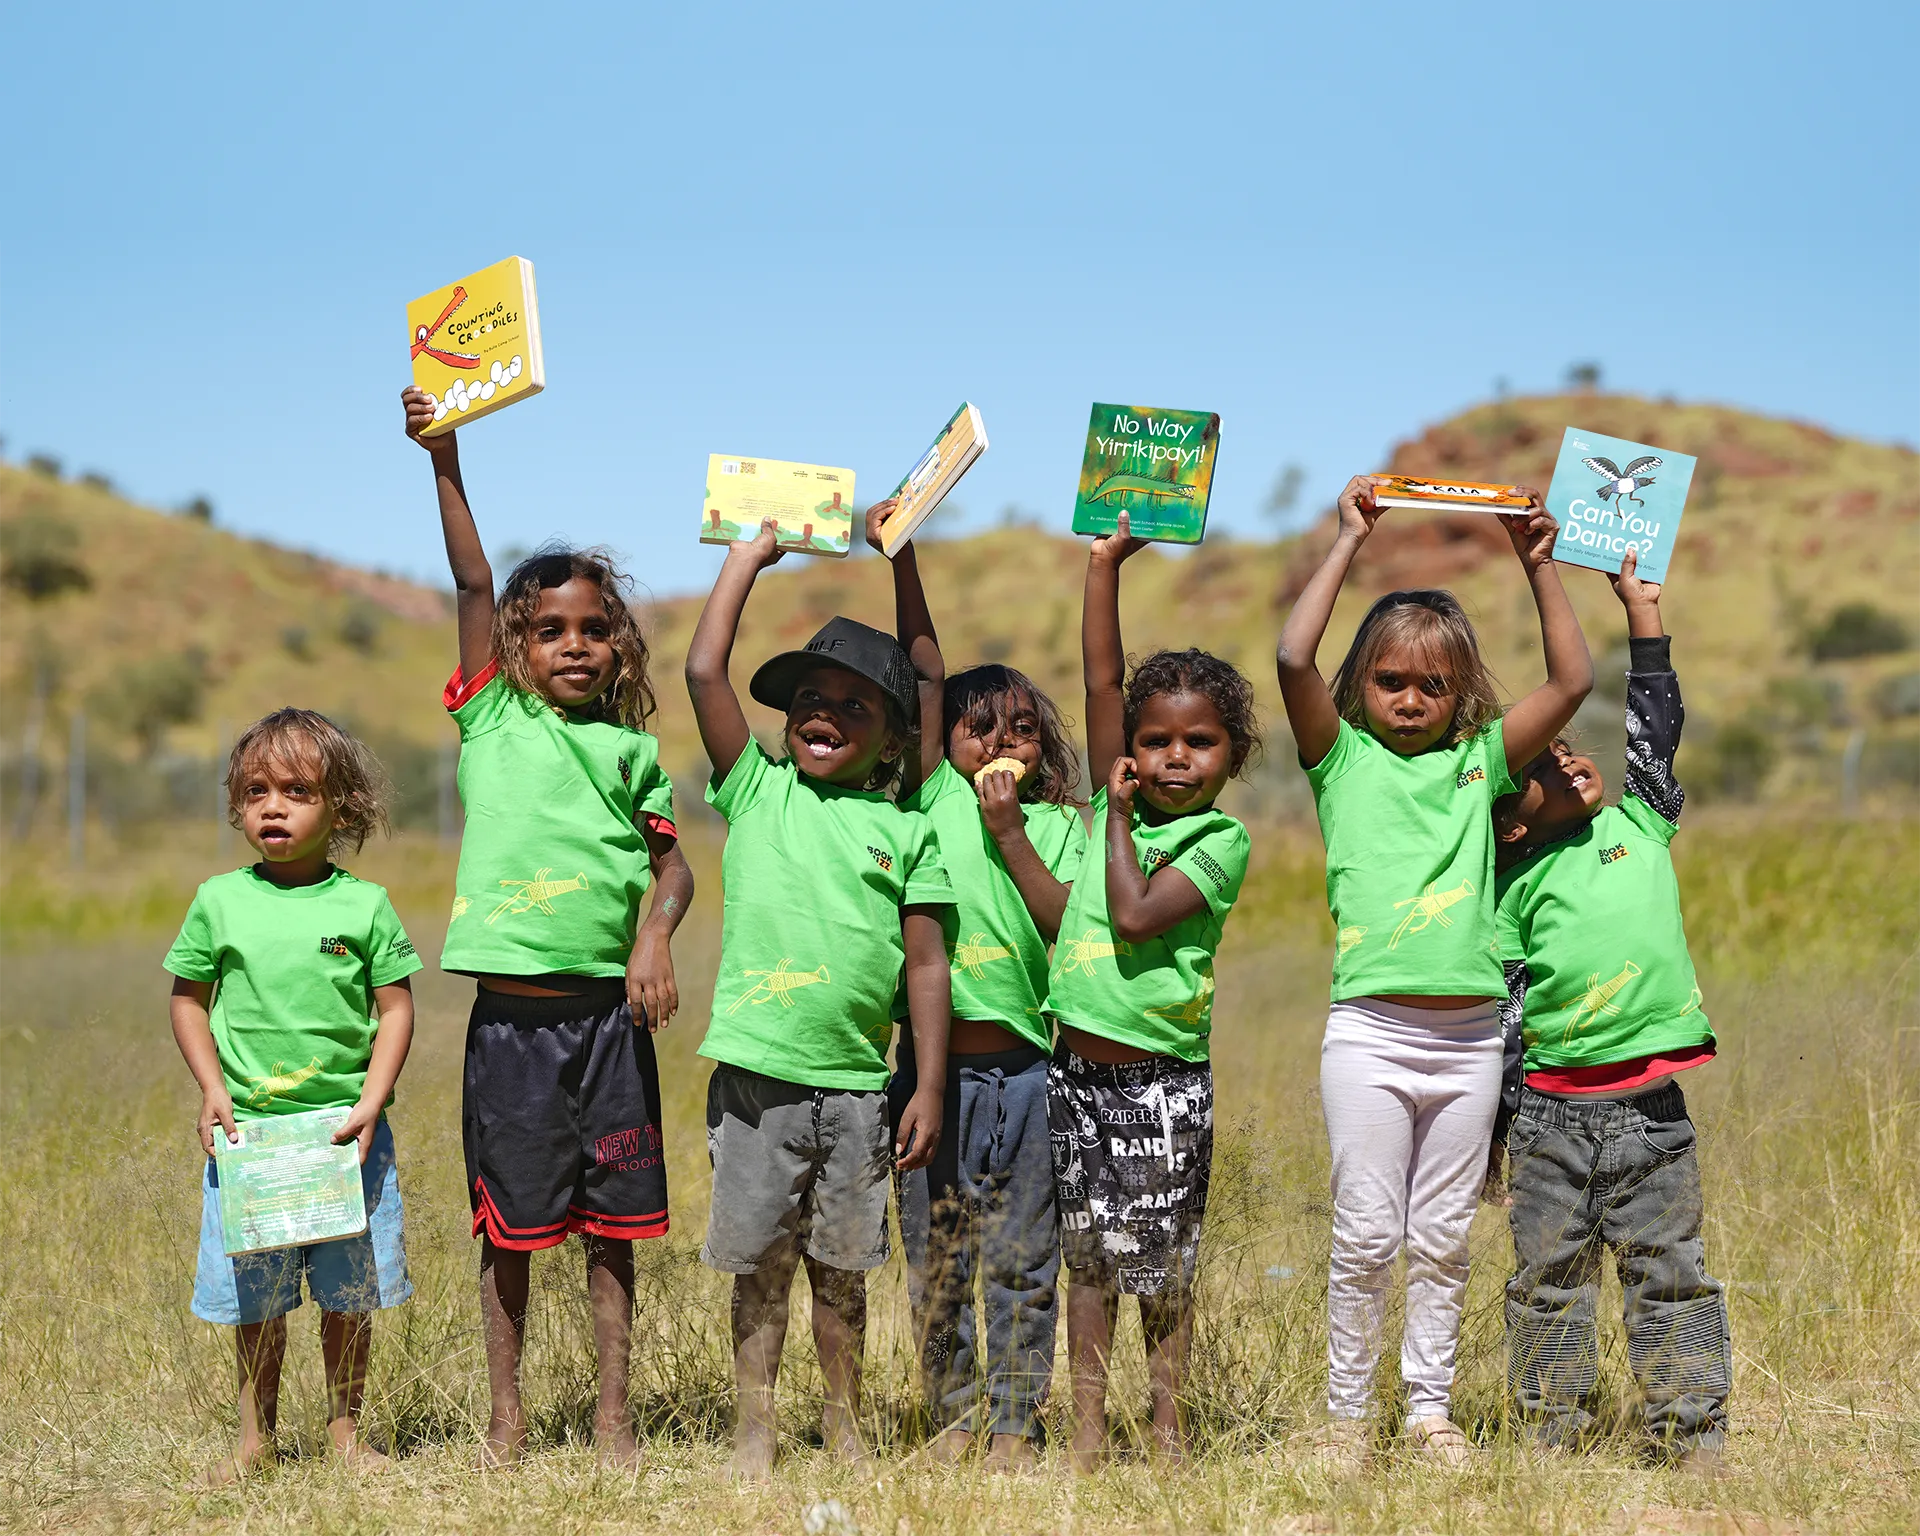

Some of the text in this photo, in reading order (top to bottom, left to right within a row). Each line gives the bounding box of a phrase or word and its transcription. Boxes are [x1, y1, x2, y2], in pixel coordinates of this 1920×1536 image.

[448, 302, 503, 335] COUNTING
[458, 312, 518, 345] CROCODILES
[1113, 414, 1194, 444] No Way
[1096, 436, 1206, 468] Yirrikipayi!
[1568, 499, 1660, 538] Can You
[1563, 520, 1653, 559] Dance?
[1457, 771, 1485, 789] BUZZ
[867, 845, 893, 864] BOOK
[1598, 842, 1624, 857] BOOK
[1600, 848, 1628, 865] BUZZ
[1190, 856, 1224, 892] FOUNDATION
[1193, 853, 1222, 880] LITERACY
[1195, 846, 1231, 884] INDIGENOUS
[320, 945, 347, 955] BUZZ
[398, 947, 415, 959] FOUND
[1101, 1108, 1162, 1124] RAIDERS
[595, 1128, 640, 1166] NEW
[1110, 1137, 1167, 1157] RAID
[1125, 1270, 1166, 1278] RAIDERS
